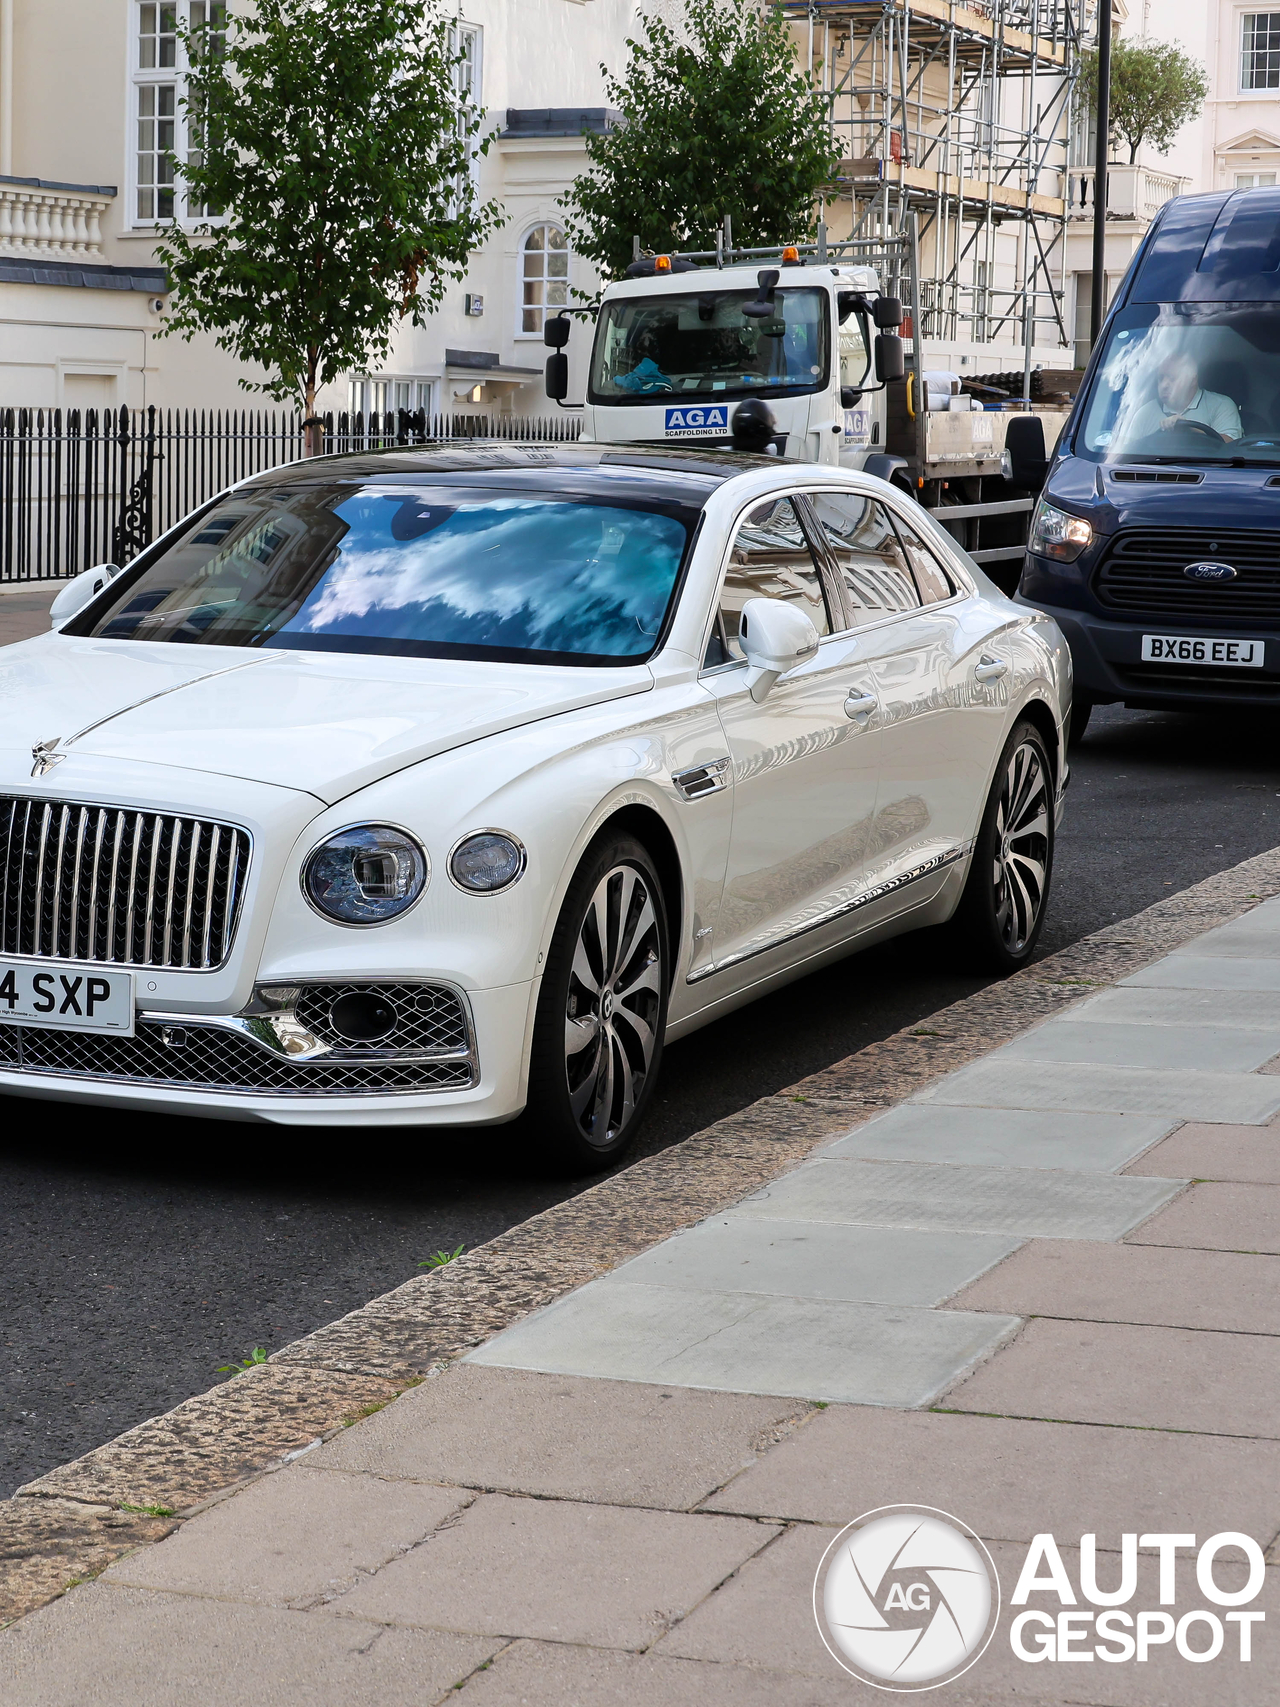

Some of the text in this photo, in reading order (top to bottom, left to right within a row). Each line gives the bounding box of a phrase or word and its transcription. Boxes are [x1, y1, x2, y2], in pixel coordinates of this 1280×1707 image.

[668, 409, 724, 427] AGA
[846, 413, 869, 433] AGA
[665, 429, 713, 437] SCAFFOLDING
[1194, 565, 1224, 578] Ford
[1151, 638, 1254, 663] BX66 EEJ
[32, 972, 111, 1017] SXP
